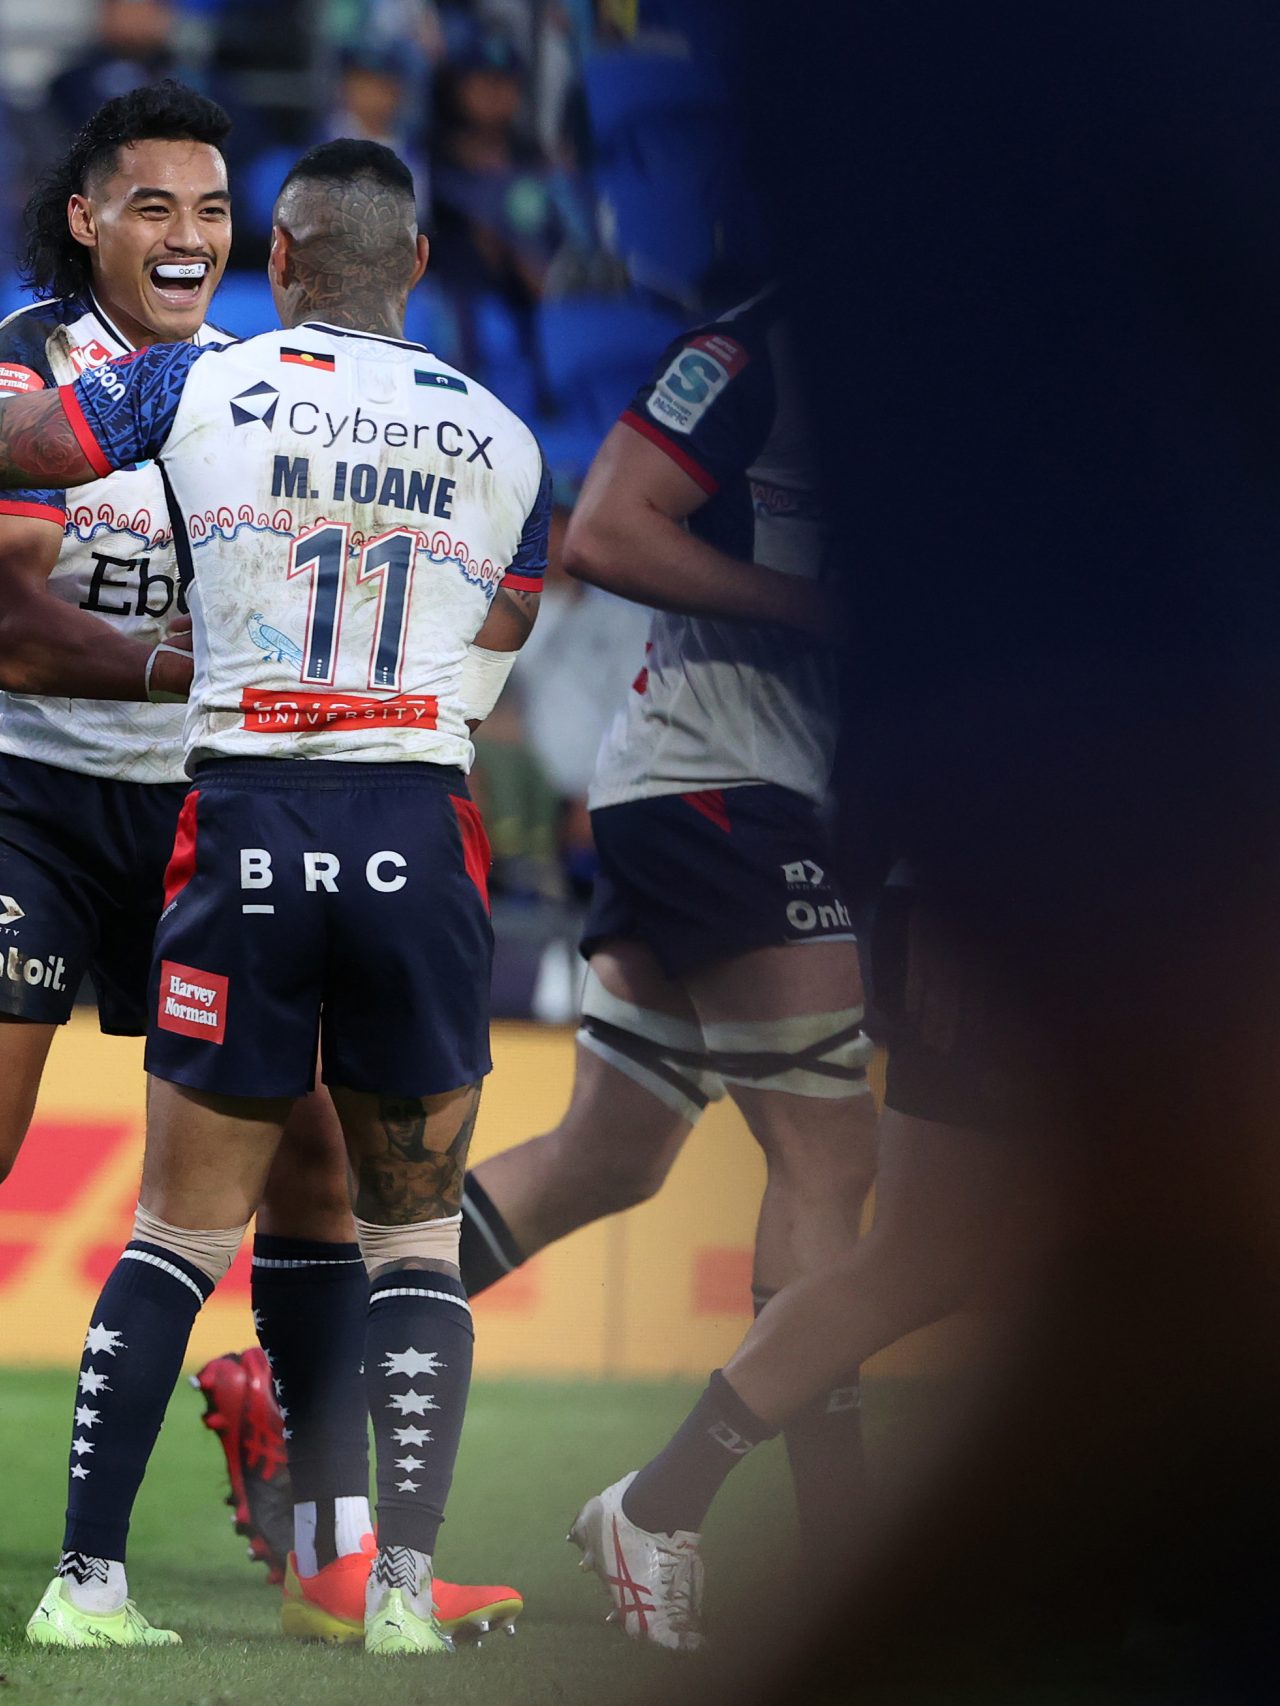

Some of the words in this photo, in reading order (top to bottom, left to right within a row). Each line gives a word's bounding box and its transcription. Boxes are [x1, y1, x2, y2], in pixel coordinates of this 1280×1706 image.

[289, 401, 494, 470] CyberCX
[271, 455, 320, 499] M.
[333, 461, 456, 520] IOANE
[287, 521, 419, 693] 11
[786, 899, 852, 931] Ont
[164, 996, 218, 1027] Norman
[170, 975, 217, 1007] Harvey
